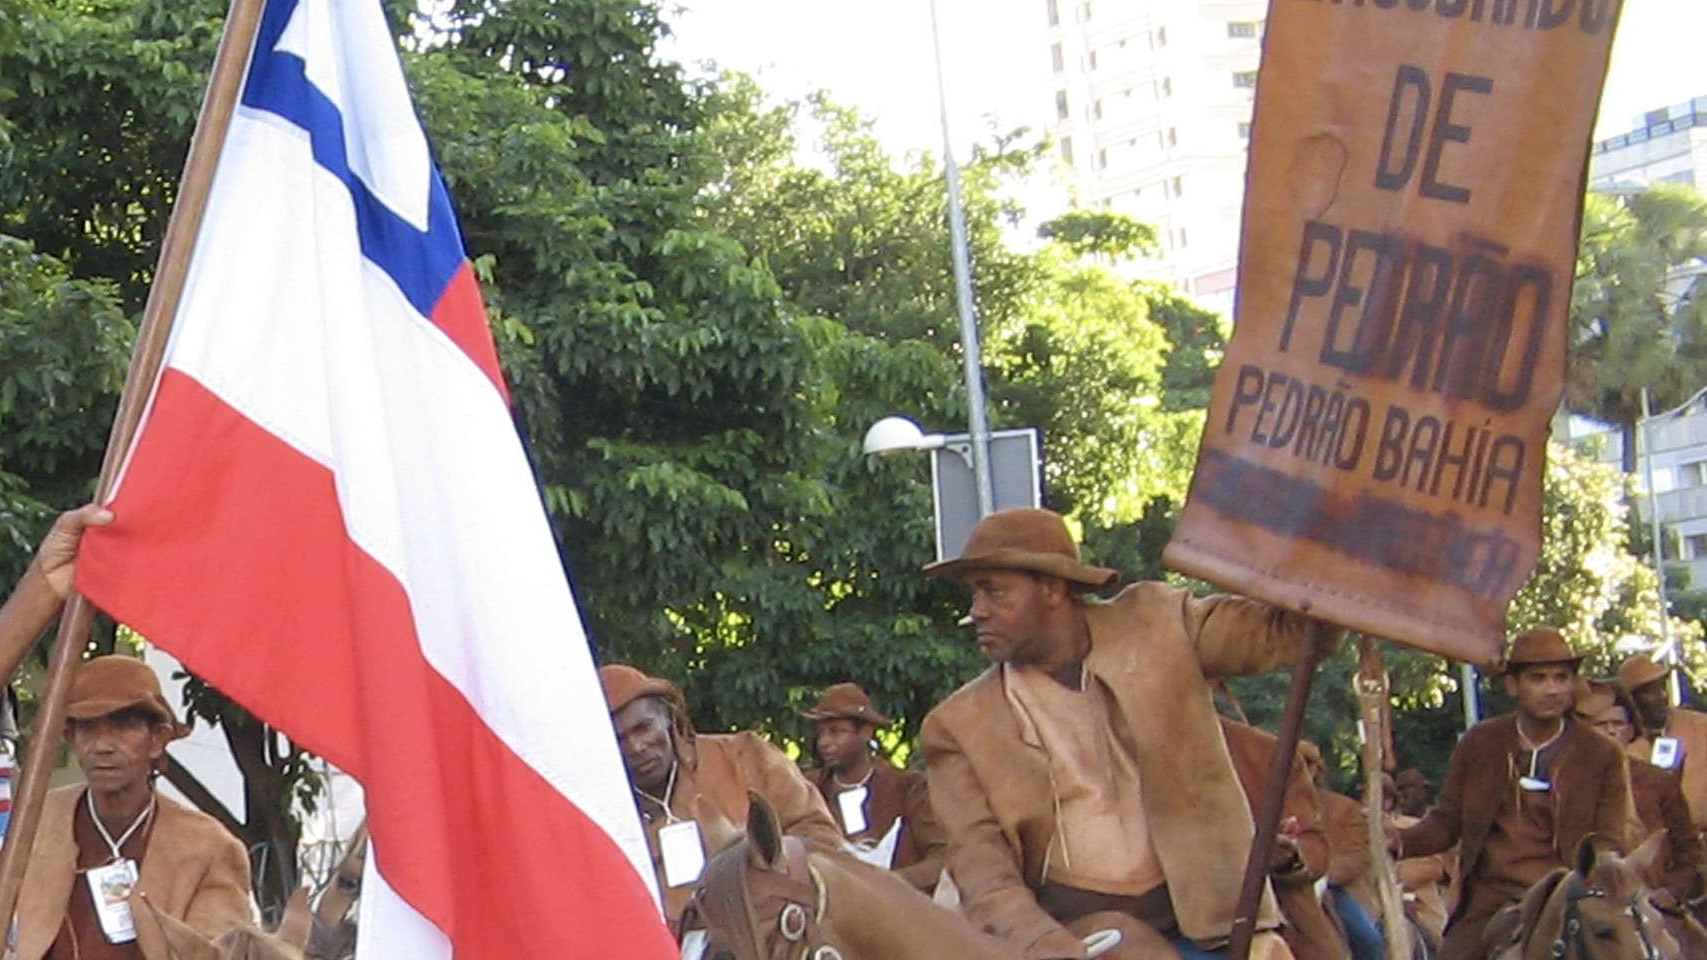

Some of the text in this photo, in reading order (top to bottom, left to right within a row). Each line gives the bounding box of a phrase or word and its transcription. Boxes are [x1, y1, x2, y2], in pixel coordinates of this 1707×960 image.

[1374, 64, 1493, 203] DE
[1279, 219, 1553, 413] PEDRÃO
[1225, 365, 1369, 471] PEDRÃO
